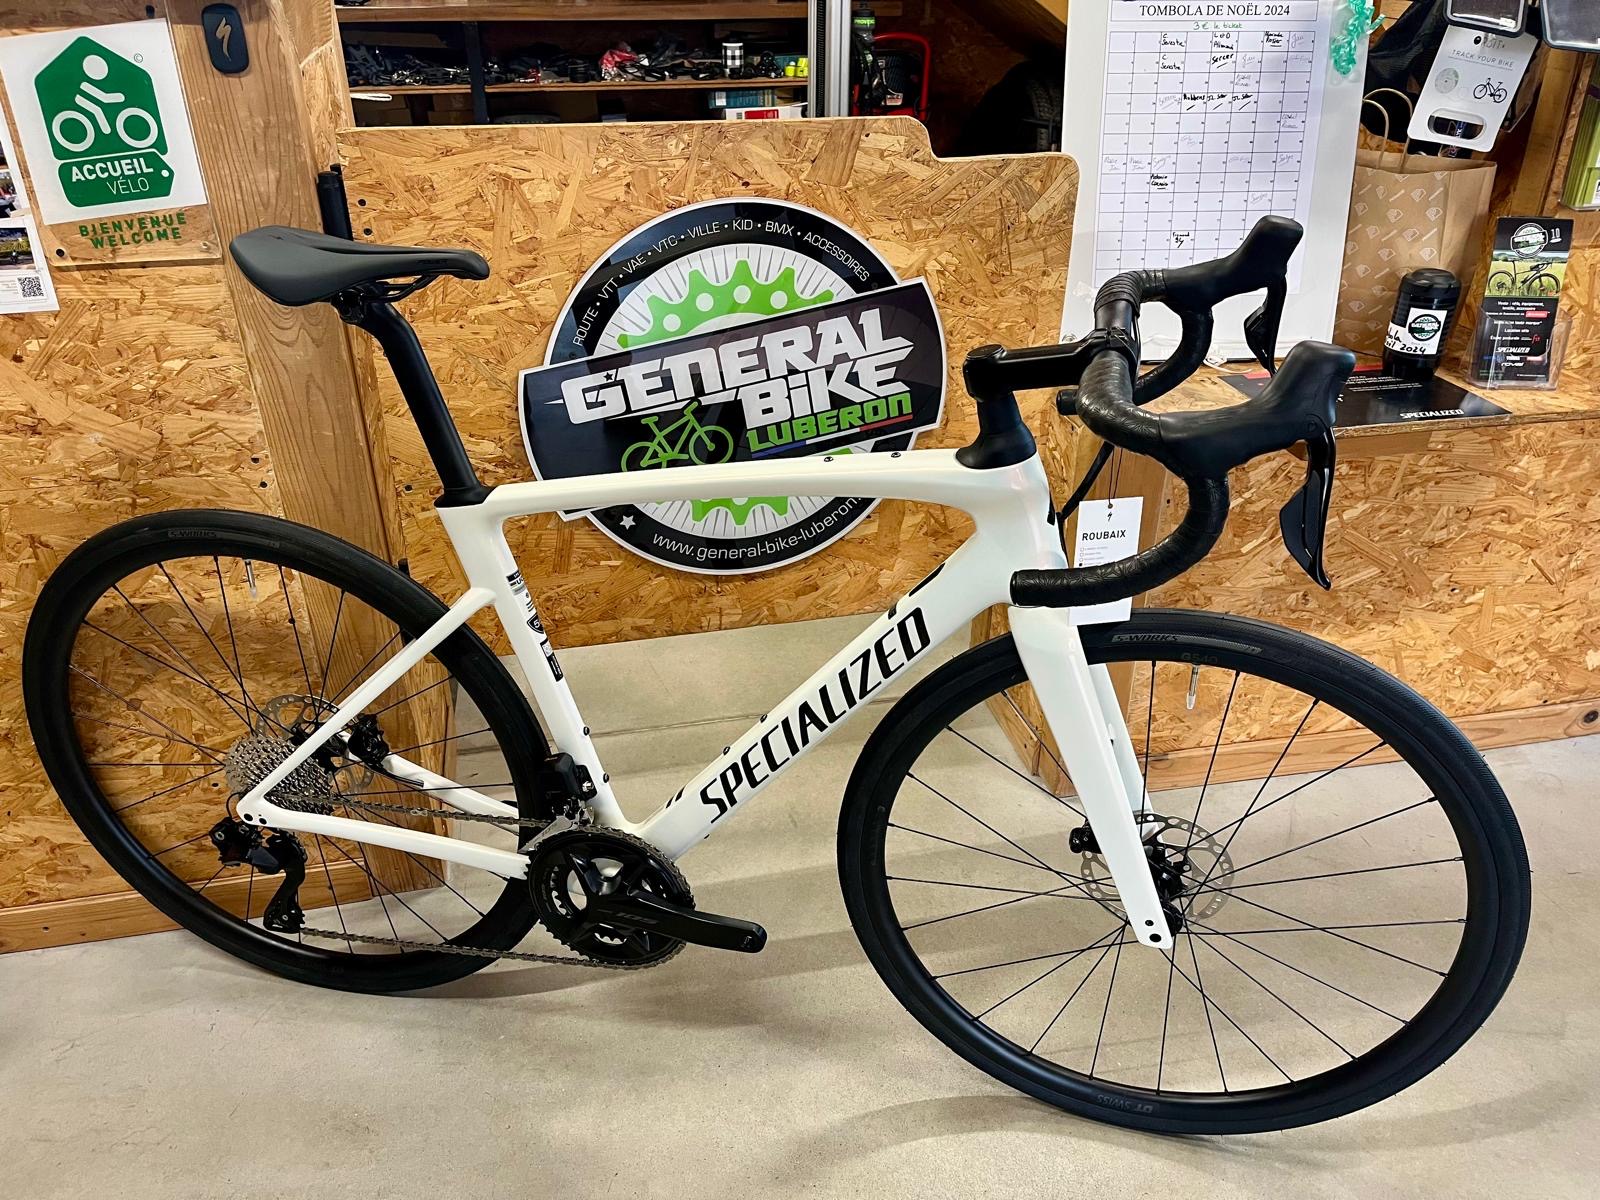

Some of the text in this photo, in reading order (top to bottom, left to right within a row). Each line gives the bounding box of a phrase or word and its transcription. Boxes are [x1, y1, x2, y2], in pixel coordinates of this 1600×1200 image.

[1140, 3, 1290, 16] TOMBOLA DE NOËL 2024
[1193, 21, 1200, 30] 3
[1223, 21, 1243, 29] ticket
[1451, 49, 1514, 68] TRACK YOUR BIKE
[71, 157, 154, 183] ACCUEIL
[106, 176, 150, 195] VÉLO
[79, 212, 187, 237] BIENVENUE
[91, 227, 182, 249] WELCOME
[573, 219, 870, 347] ROUTE VTT VAE VTC VILLE KID BMX ACCESSOIRES
[1400, 343, 1426, 355] 2024
[558, 308, 914, 425] GENERAL
[746, 392, 912, 452] LUBERON
[1400, 408, 1464, 420] SPECIALIZED
[1082, 529, 1127, 541] ROUBAIX
[1117, 633, 1179, 643] S-WORKS
[699, 606, 931, 824] SPECIALIZED
